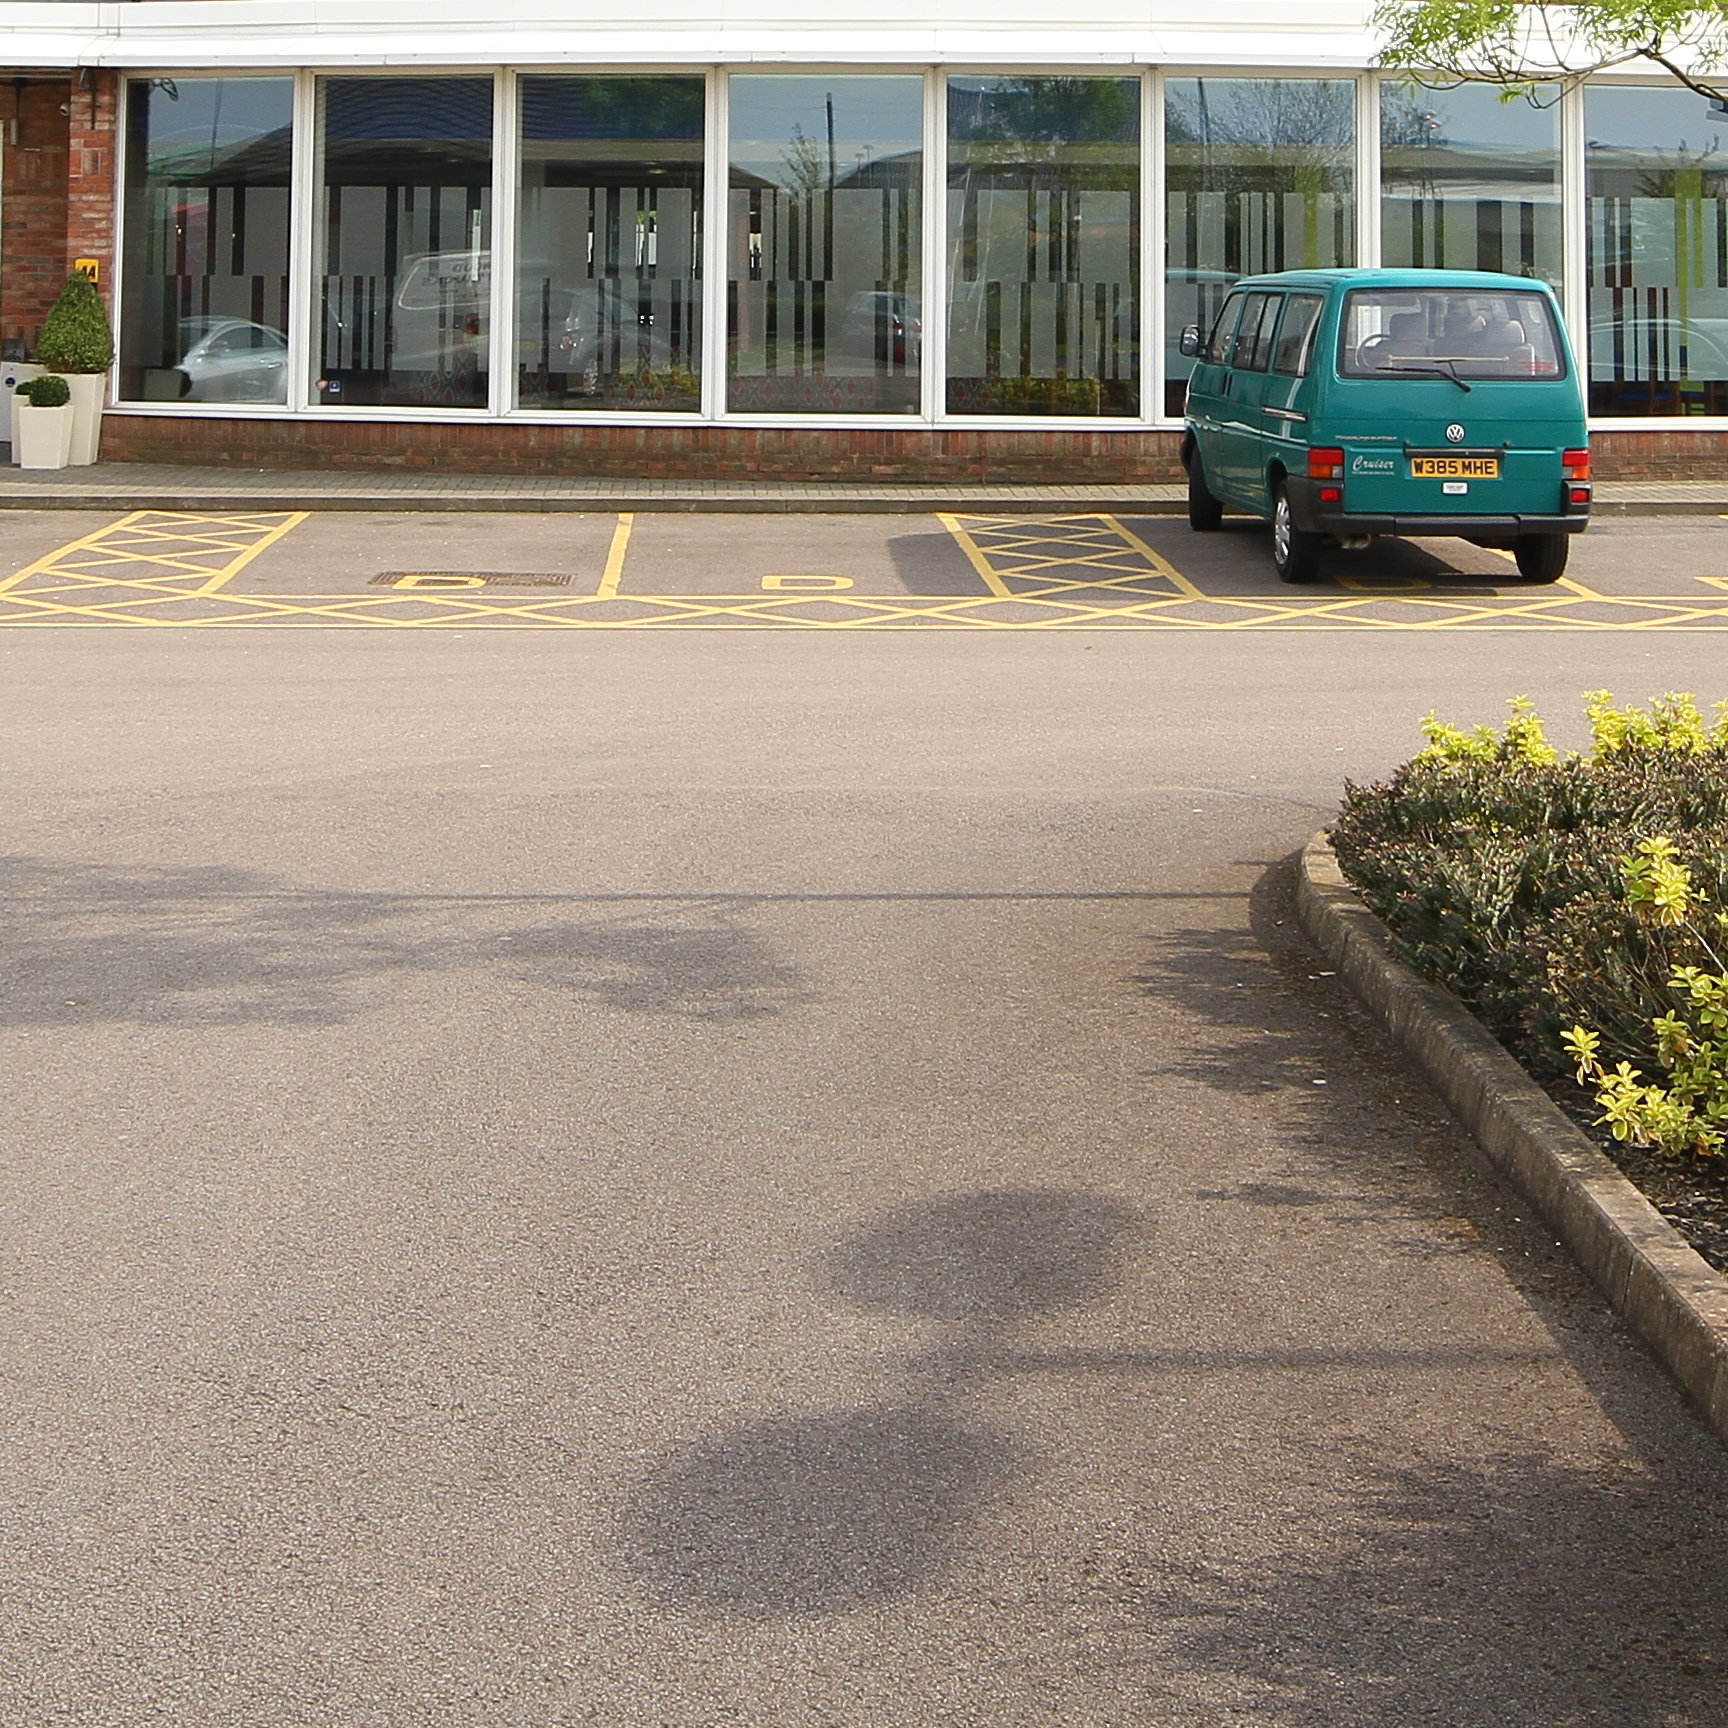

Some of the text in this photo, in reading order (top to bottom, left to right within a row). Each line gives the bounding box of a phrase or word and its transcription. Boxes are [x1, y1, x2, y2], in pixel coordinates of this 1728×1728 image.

[1352, 455, 1395, 471] Cruiser
[1413, 459, 1495, 475] W385 MHE
